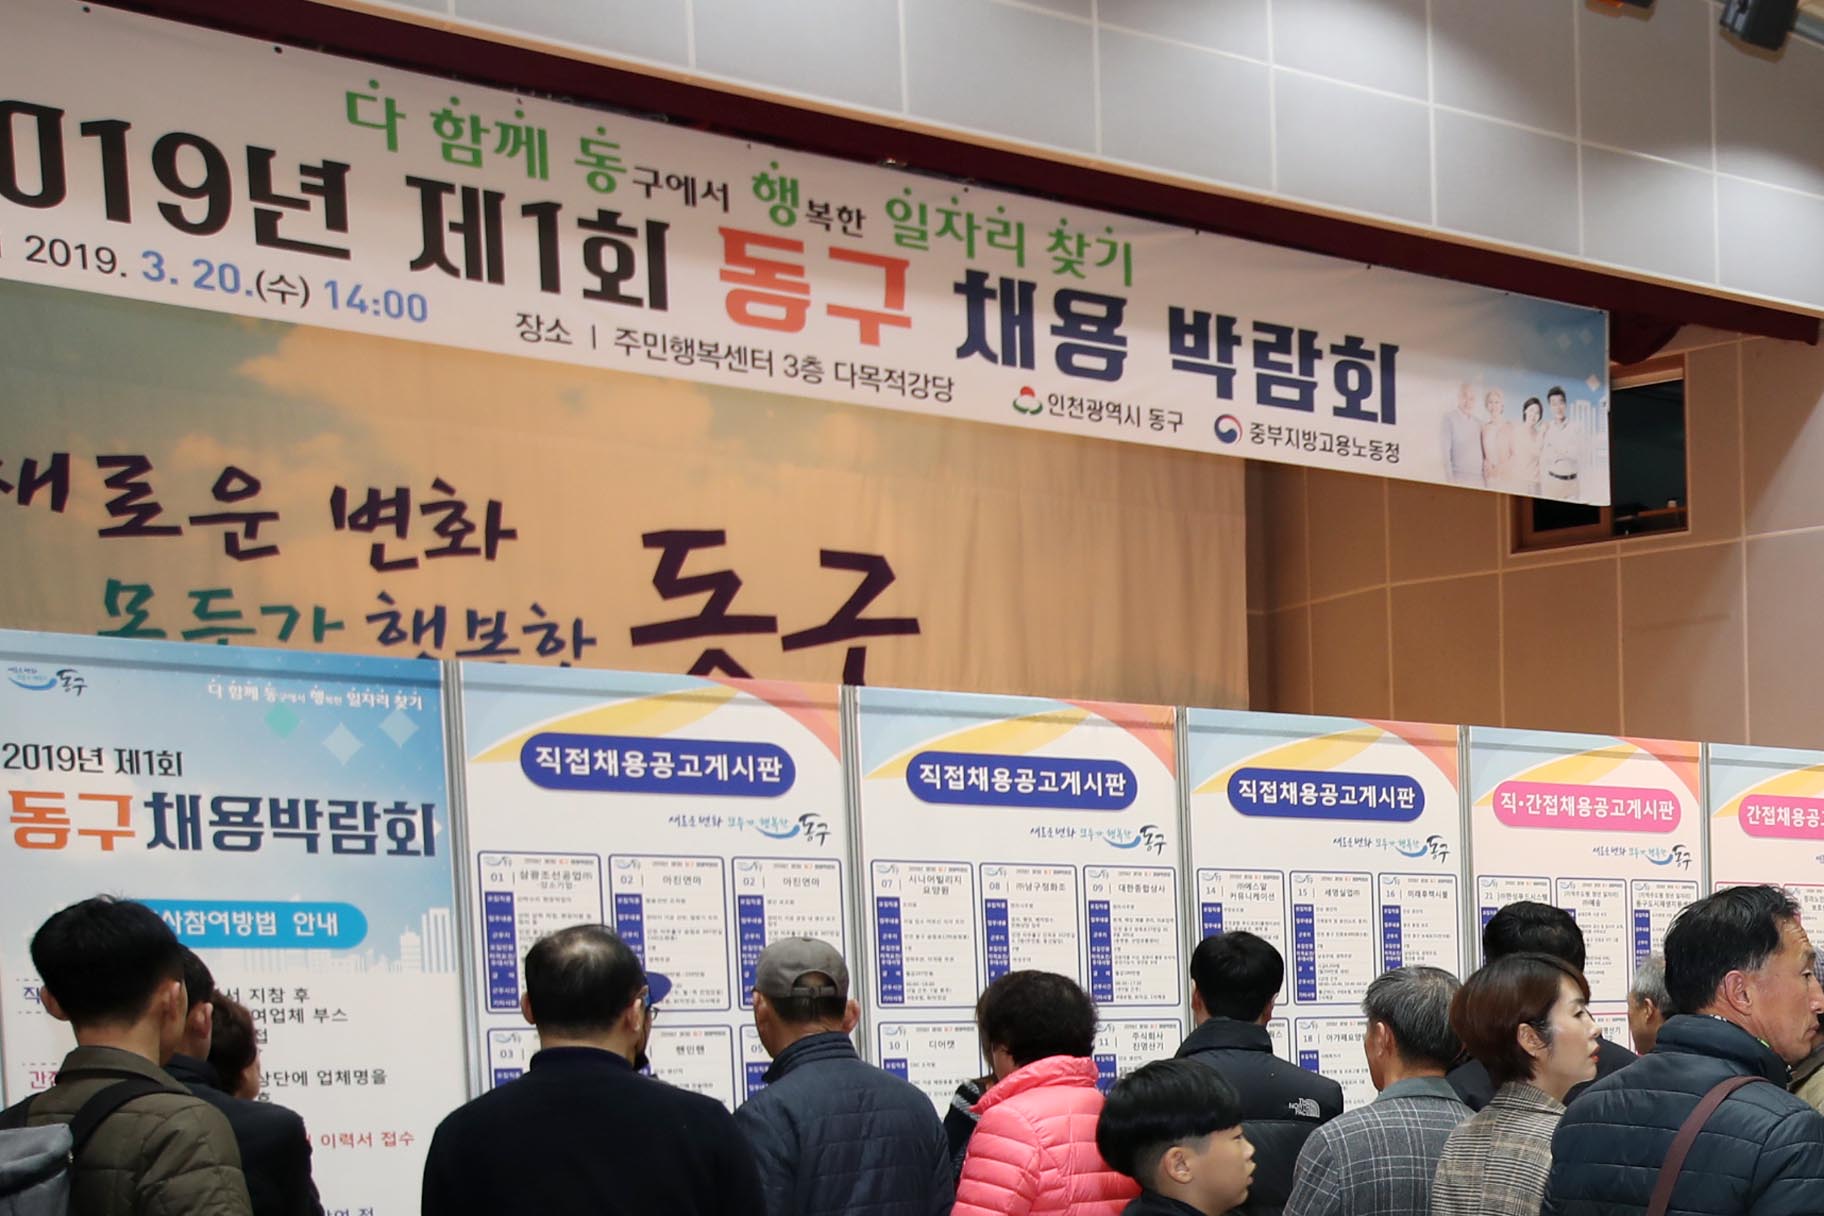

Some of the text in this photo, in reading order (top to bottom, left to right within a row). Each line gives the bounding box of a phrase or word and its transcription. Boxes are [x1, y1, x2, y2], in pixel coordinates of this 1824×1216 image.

[346, 80, 1134, 287] 다 함께 동구에서 행복한 일자리 찾기
[24, 234, 128, 280] 2019.
[324, 279, 429, 324] 14:00
[406, 175, 670, 313] 제1회
[718, 224, 912, 347] 동구
[954, 268, 1129, 383] 채용
[1168, 305, 1400, 425] 박람회
[516, 312, 955, 404] 장소 주민행복센터 3층 다목적강당
[1047, 392, 1186, 434] 인천광역시 동구
[1249, 422, 1401, 465] 중부지방고용노동청
[331, 476, 519, 573] 변화
[631, 529, 922, 687] 동구
[2, 742, 184, 778] 2019년 제1회
[535, 745, 783, 784] 직접채용공고게시판
[919, 763, 1126, 798] 직접채용공고게시판
[1239, 778, 1416, 809] 직접채용공고게시판
[1501, 791, 1675, 821] 직·간접채용공고게시판
[490, 872, 505, 882] 01
[620, 876, 634, 885] 02
[743, 877, 756, 887] 02
[881, 880, 893, 888] 07
[989, 881, 1001, 890] 08
[292, 911, 339, 937] 안내
[250, 987, 286, 1004] 지참
[293, 987, 311, 1004] 후
[313, 1008, 349, 1024] 부스
[500, 1047, 514, 1060] 03
[889, 1040, 901, 1050] 10
[317, 1068, 388, 1087] 업체명을
[321, 1131, 373, 1149] 이력서
[382, 1130, 415, 1148] 접수
